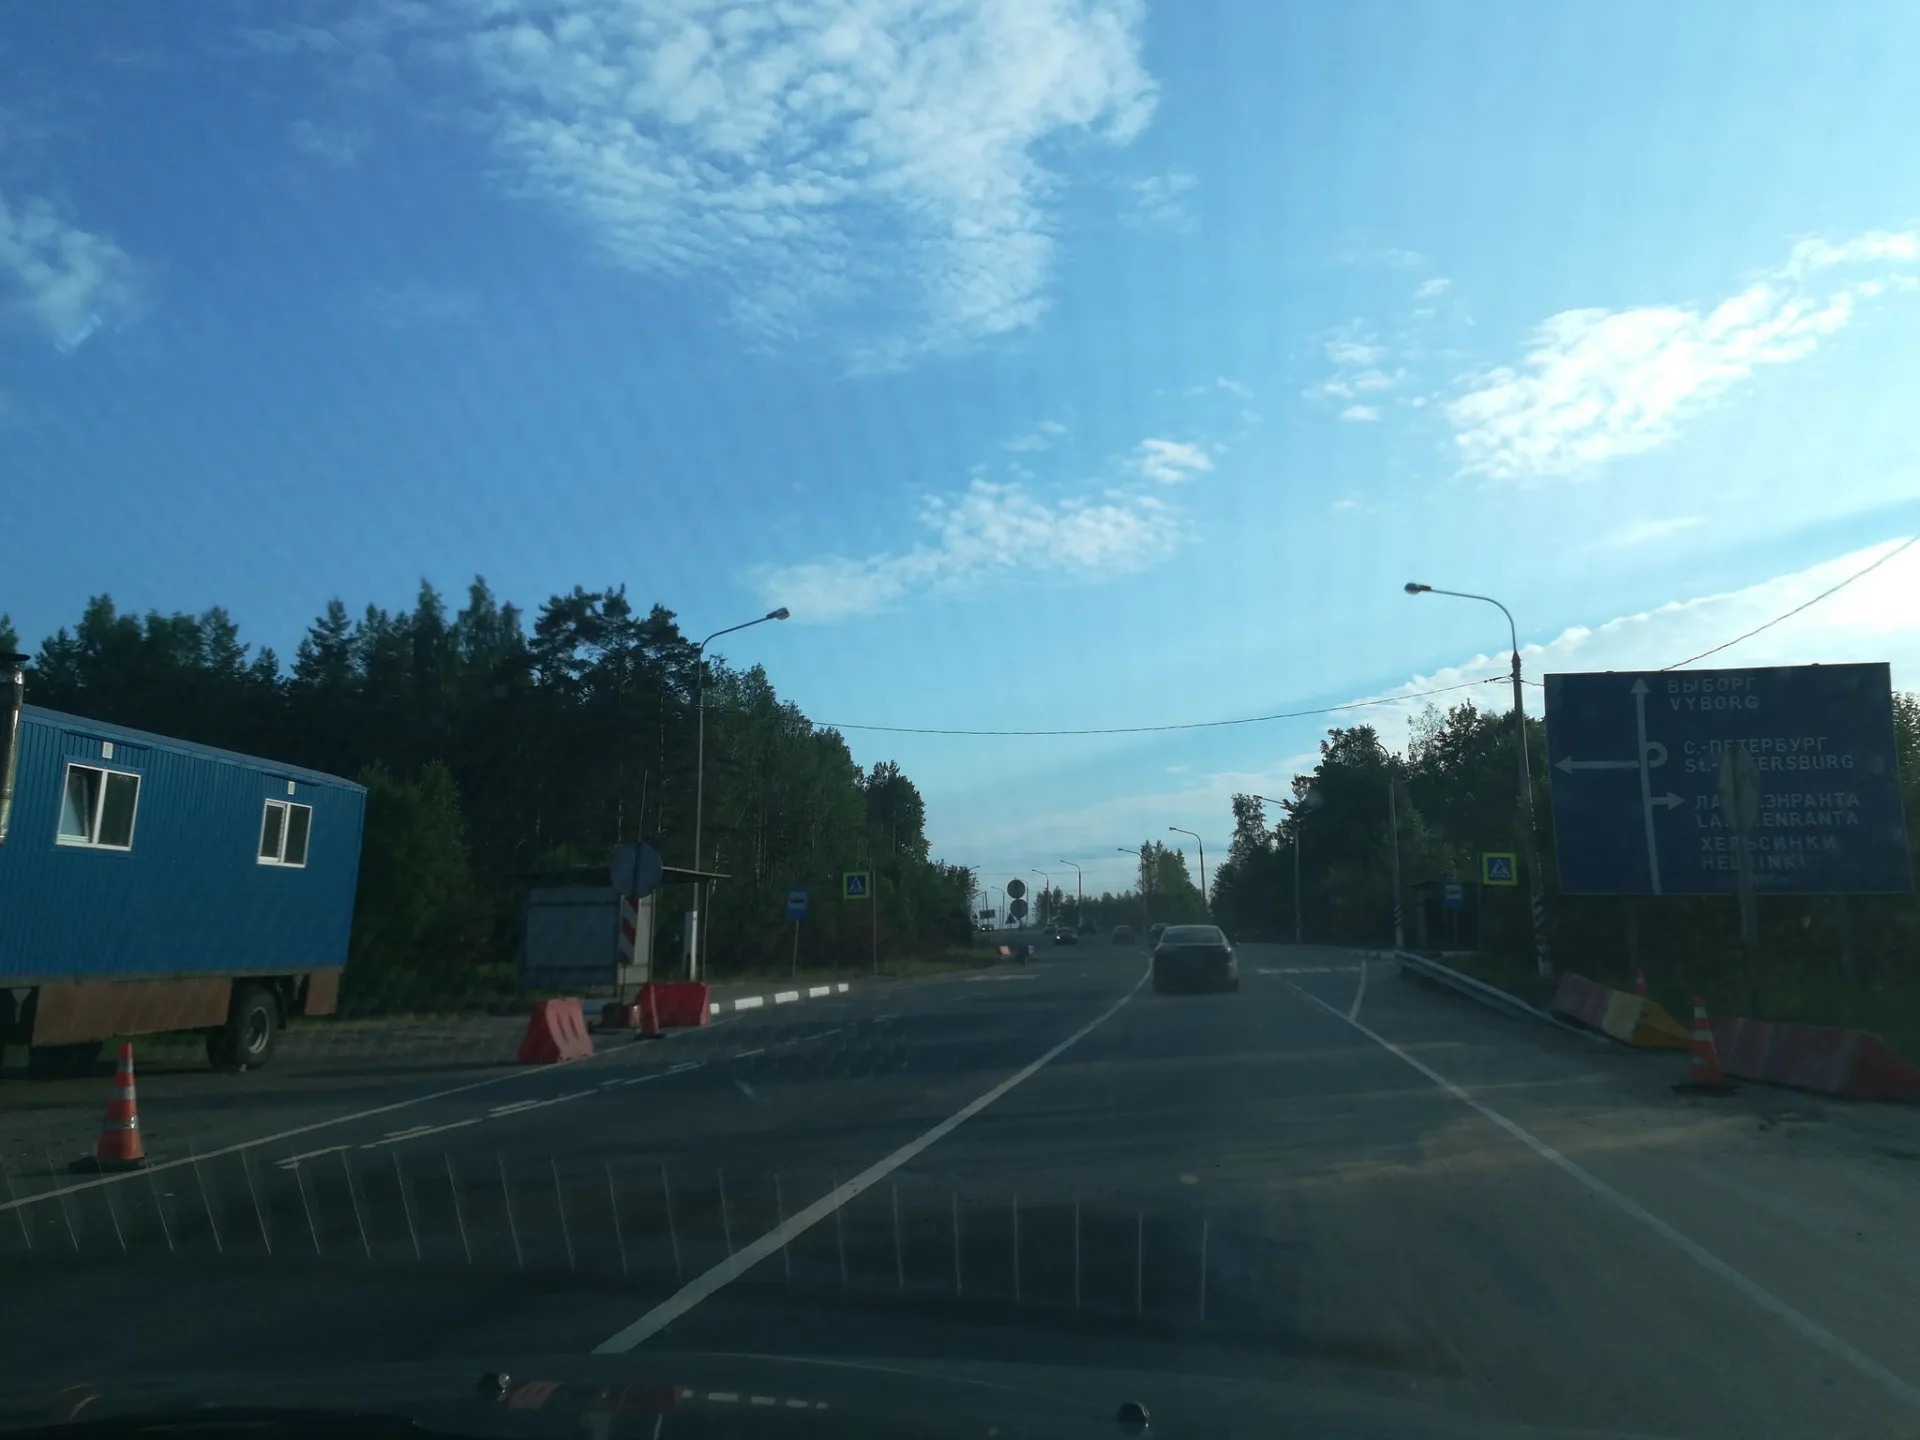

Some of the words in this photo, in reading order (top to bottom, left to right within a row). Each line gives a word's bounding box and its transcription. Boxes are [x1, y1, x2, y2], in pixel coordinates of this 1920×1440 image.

[1668, 677, 1757, 693] ВЫБОРГ
[1670, 694, 1760, 711] VYBORG
[1685, 753, 1855, 773] St.-ERSBURG
[1694, 792, 1860, 810] ЛАЭНРАНТА
[1695, 810, 1861, 828] LAENRANTA
[1701, 853, 1807, 870] HELINKI
